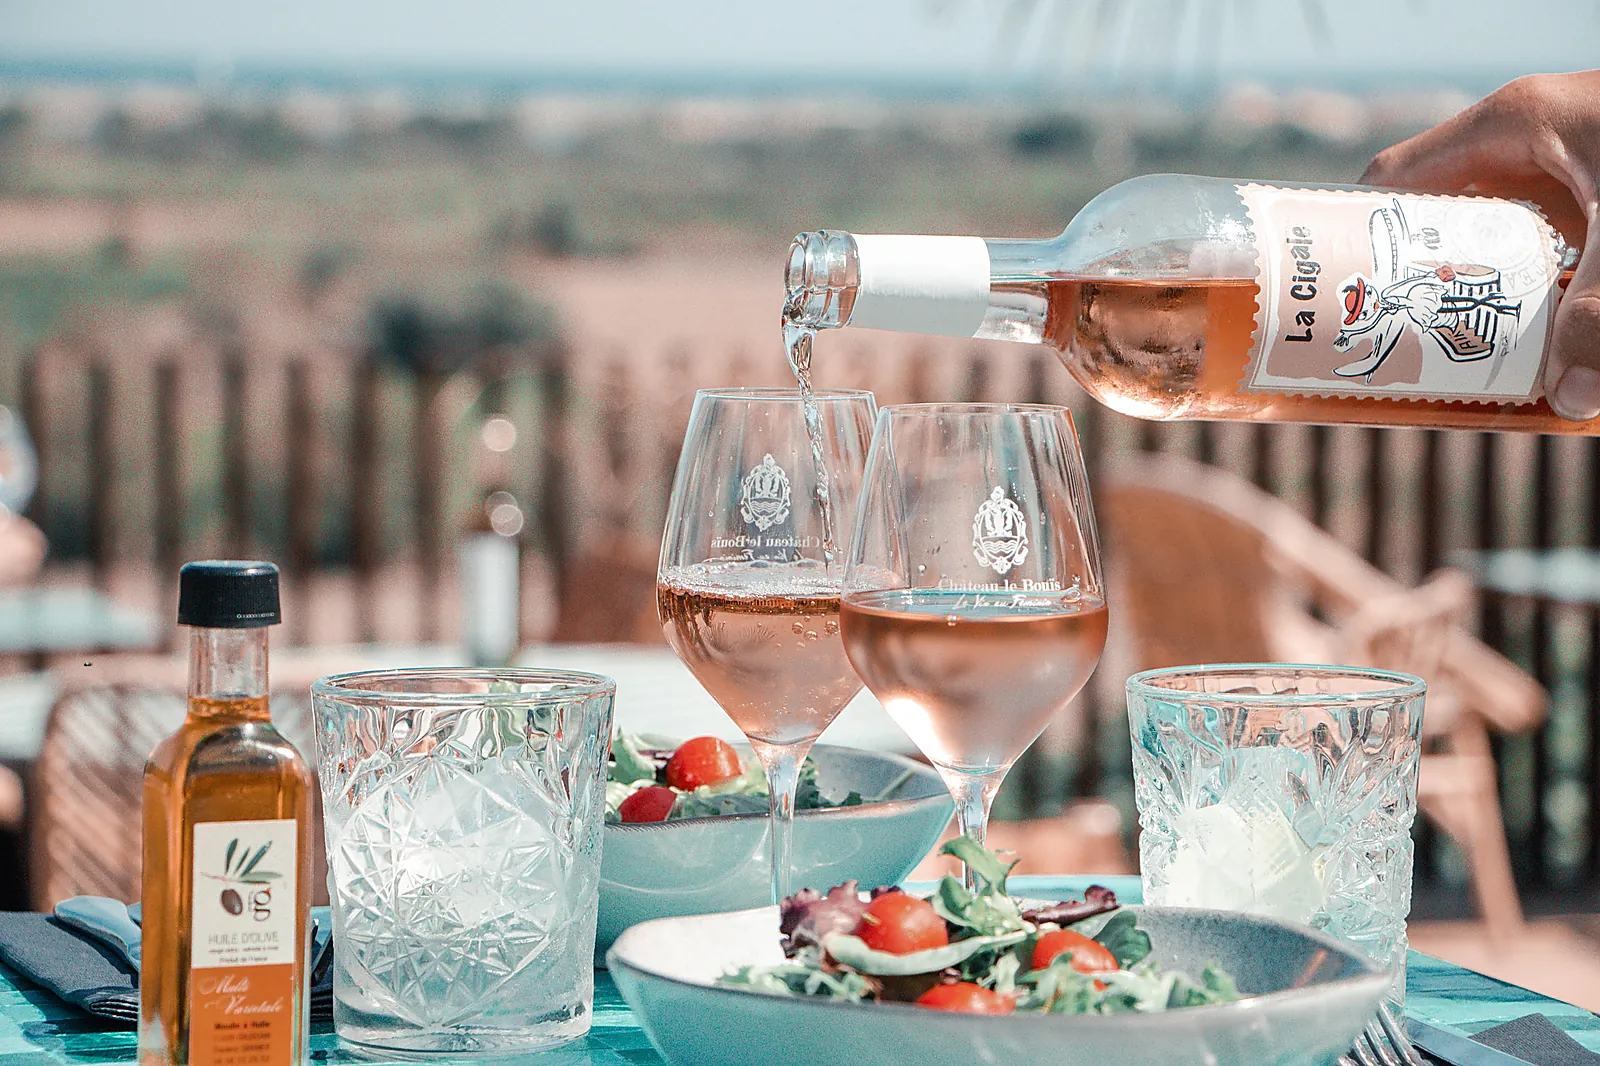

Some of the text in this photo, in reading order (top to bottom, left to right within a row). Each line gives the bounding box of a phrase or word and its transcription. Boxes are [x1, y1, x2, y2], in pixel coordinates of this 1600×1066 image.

[1285, 226, 1321, 342] La Cigale
[938, 578, 1061, 592] Château le Bouïs
[208, 933, 239, 945] HUILE
